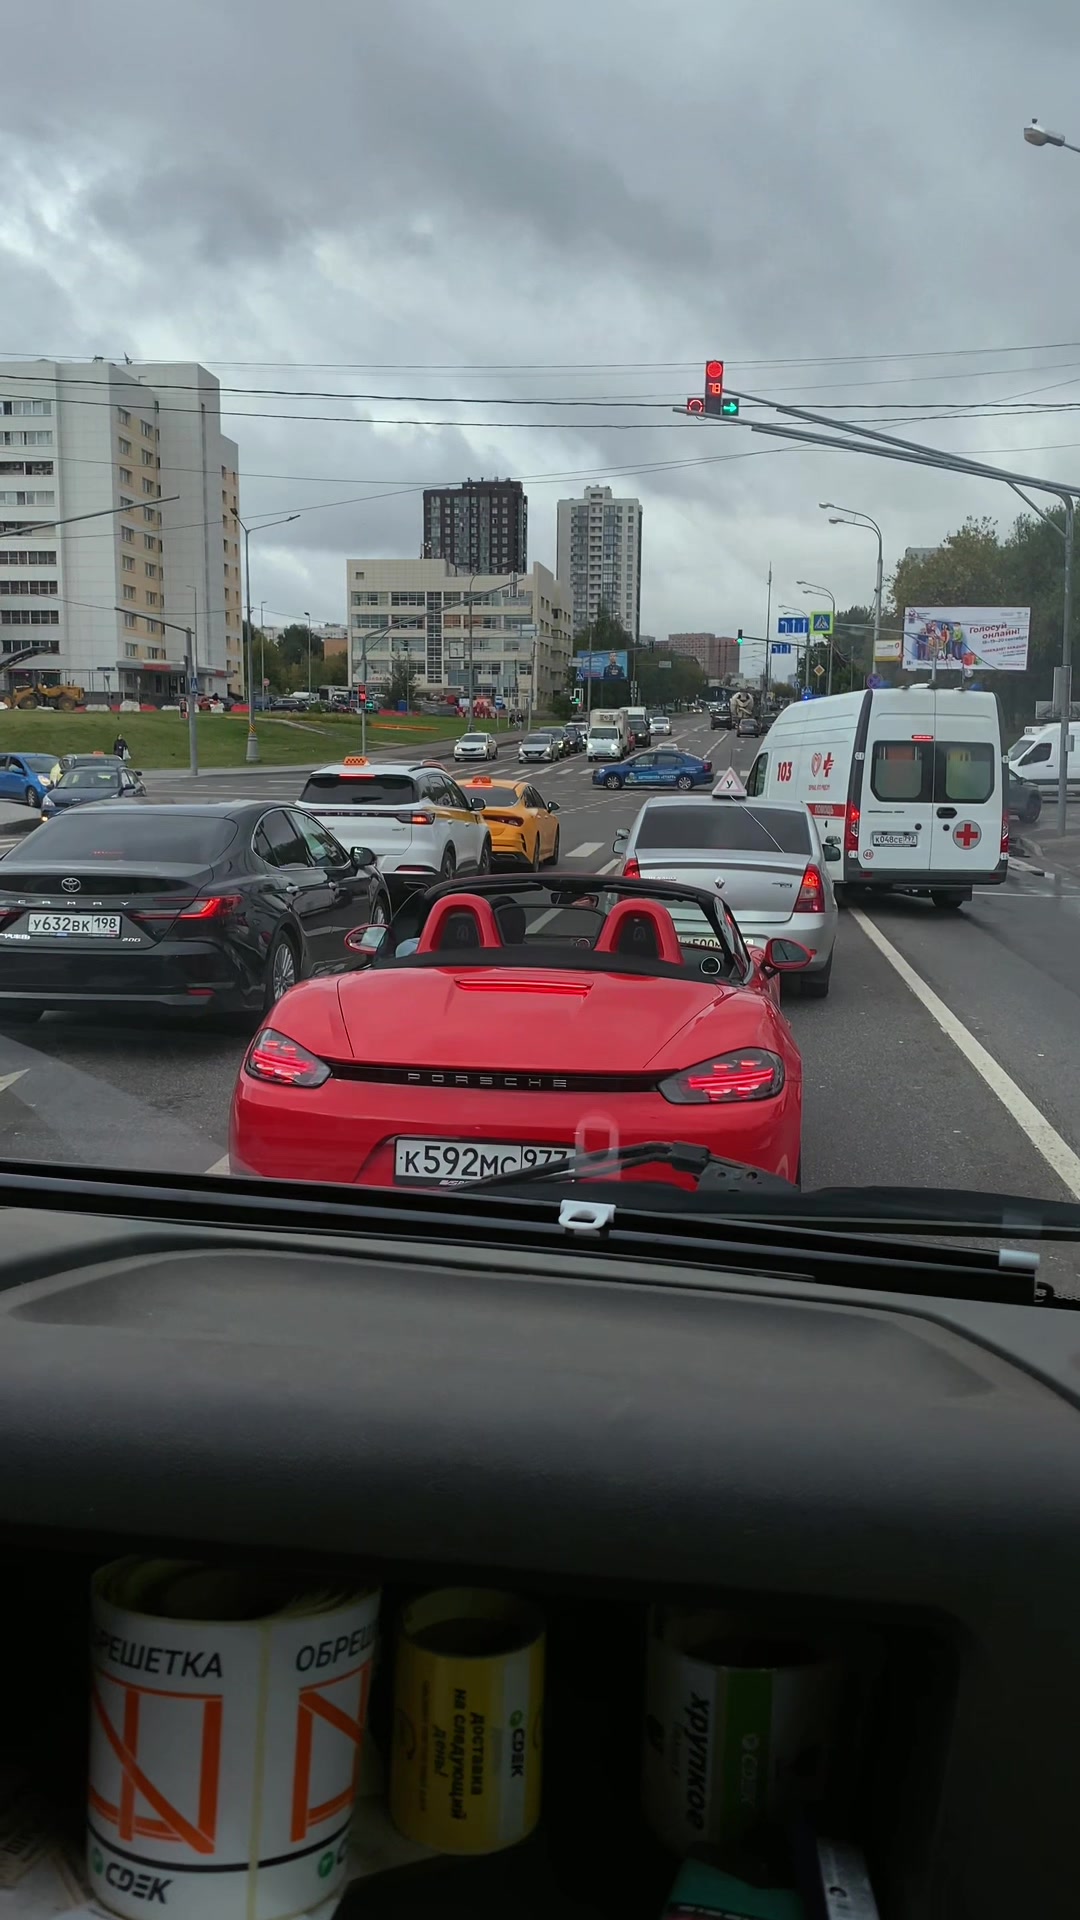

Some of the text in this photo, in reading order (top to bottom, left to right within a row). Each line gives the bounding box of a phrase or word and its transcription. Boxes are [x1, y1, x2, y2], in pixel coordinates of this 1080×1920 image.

[708, 383, 721, 394] 78
[970, 622, 1007, 634] Голосуй
[982, 628, 1020, 639] онлайн!
[777, 762, 793, 781] 103
[33, 916, 117, 932] У632ВК 198
[408, 1072, 567, 1088] PORSCHE
[404, 1145, 517, 1177] К592МС
[449, 1688, 467, 1820] на следующий
[511, 1728, 526, 1778] CDEK
[105, 1862, 174, 1904] CDEK
